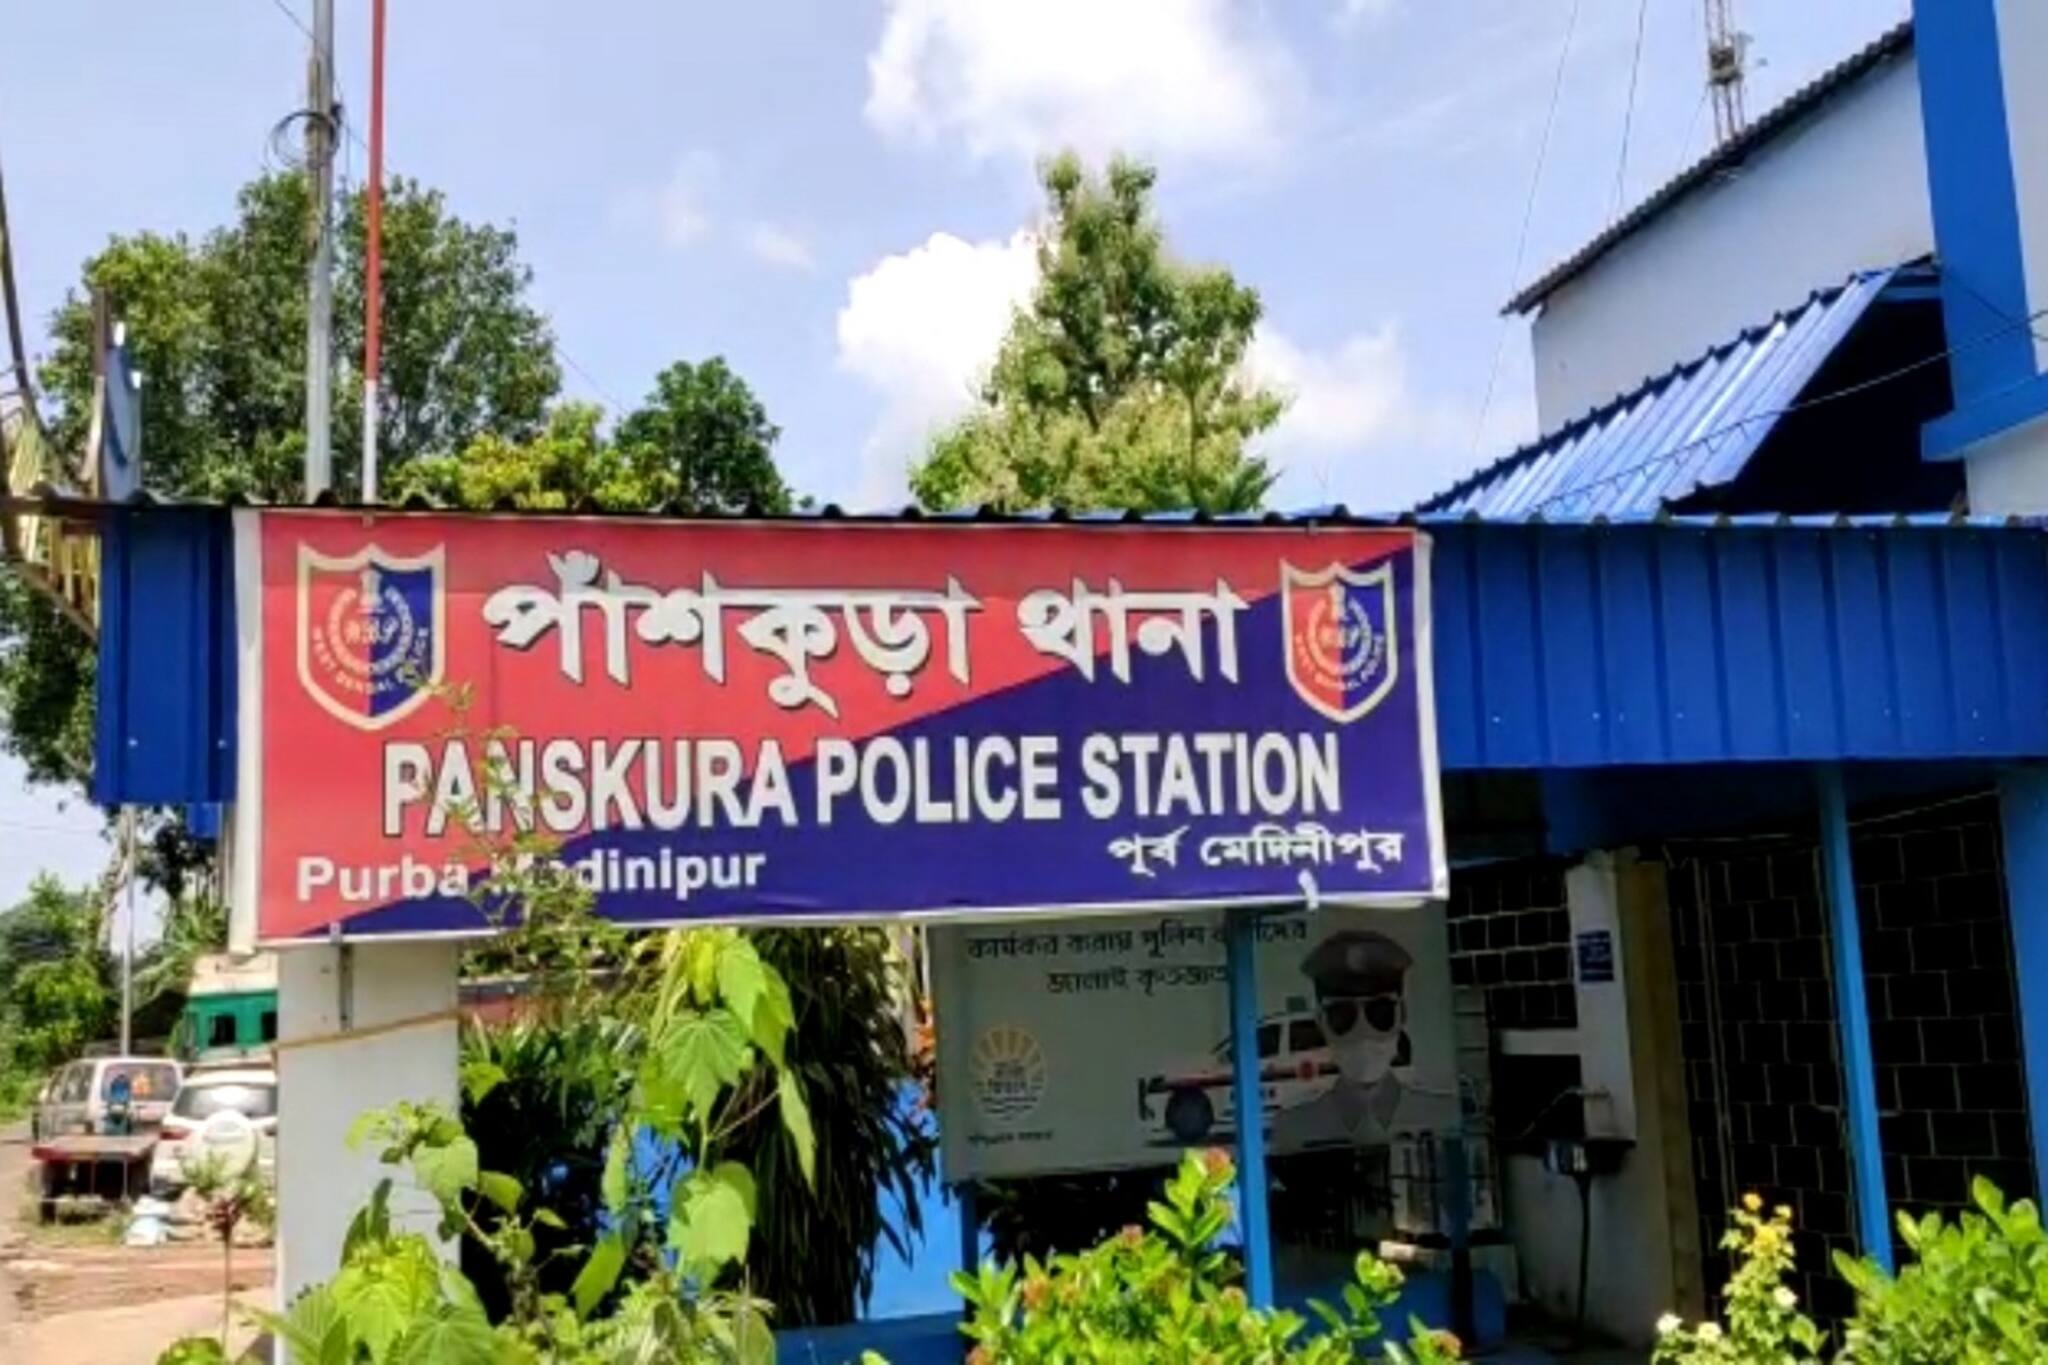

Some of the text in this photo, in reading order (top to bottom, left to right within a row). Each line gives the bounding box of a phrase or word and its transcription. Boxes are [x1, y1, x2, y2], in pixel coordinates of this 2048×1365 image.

[483, 550, 983, 718] পাঁশকুড়া
[1016, 576, 1255, 685] থানা
[383, 731, 1343, 837] PANSKURA POLICE STATION
[297, 855, 469, 902] Purba
[1200, 821, 1405, 874] মেদিনীপুর
